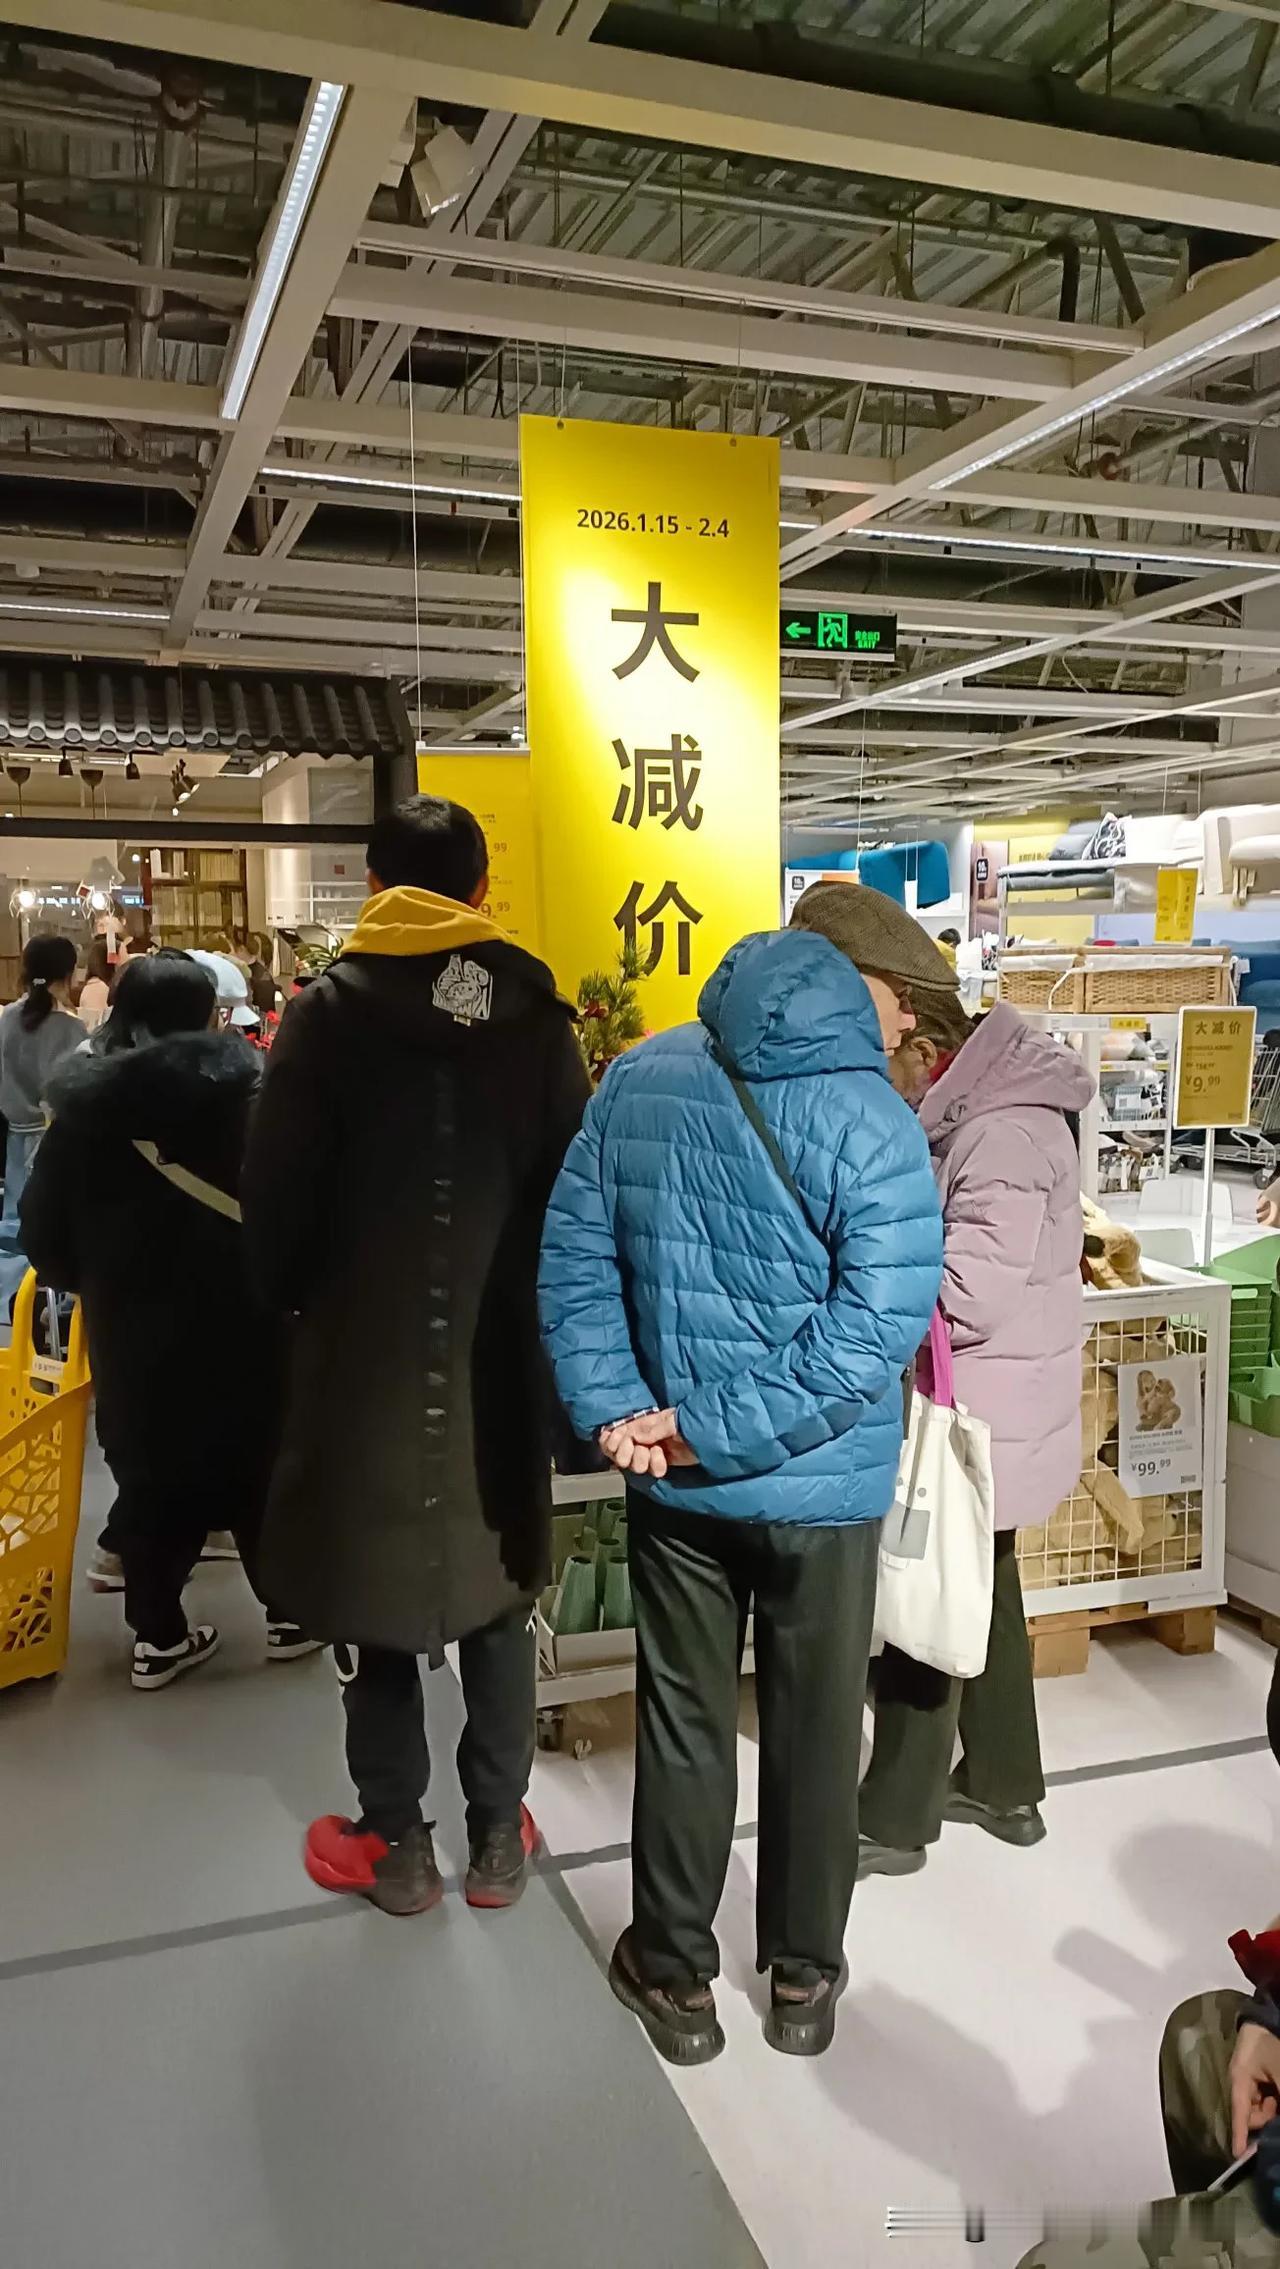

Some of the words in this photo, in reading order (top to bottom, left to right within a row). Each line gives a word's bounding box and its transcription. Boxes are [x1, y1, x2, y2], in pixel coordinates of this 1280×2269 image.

[577, 509, 679, 534] 2026.1.15
[699, 518, 729, 537] 2.4
[611, 581, 704, 976] 大减价
[1195, 1020, 1241, 1035] 大减价
[1131, 1458, 1171, 1477] ¥99.99
